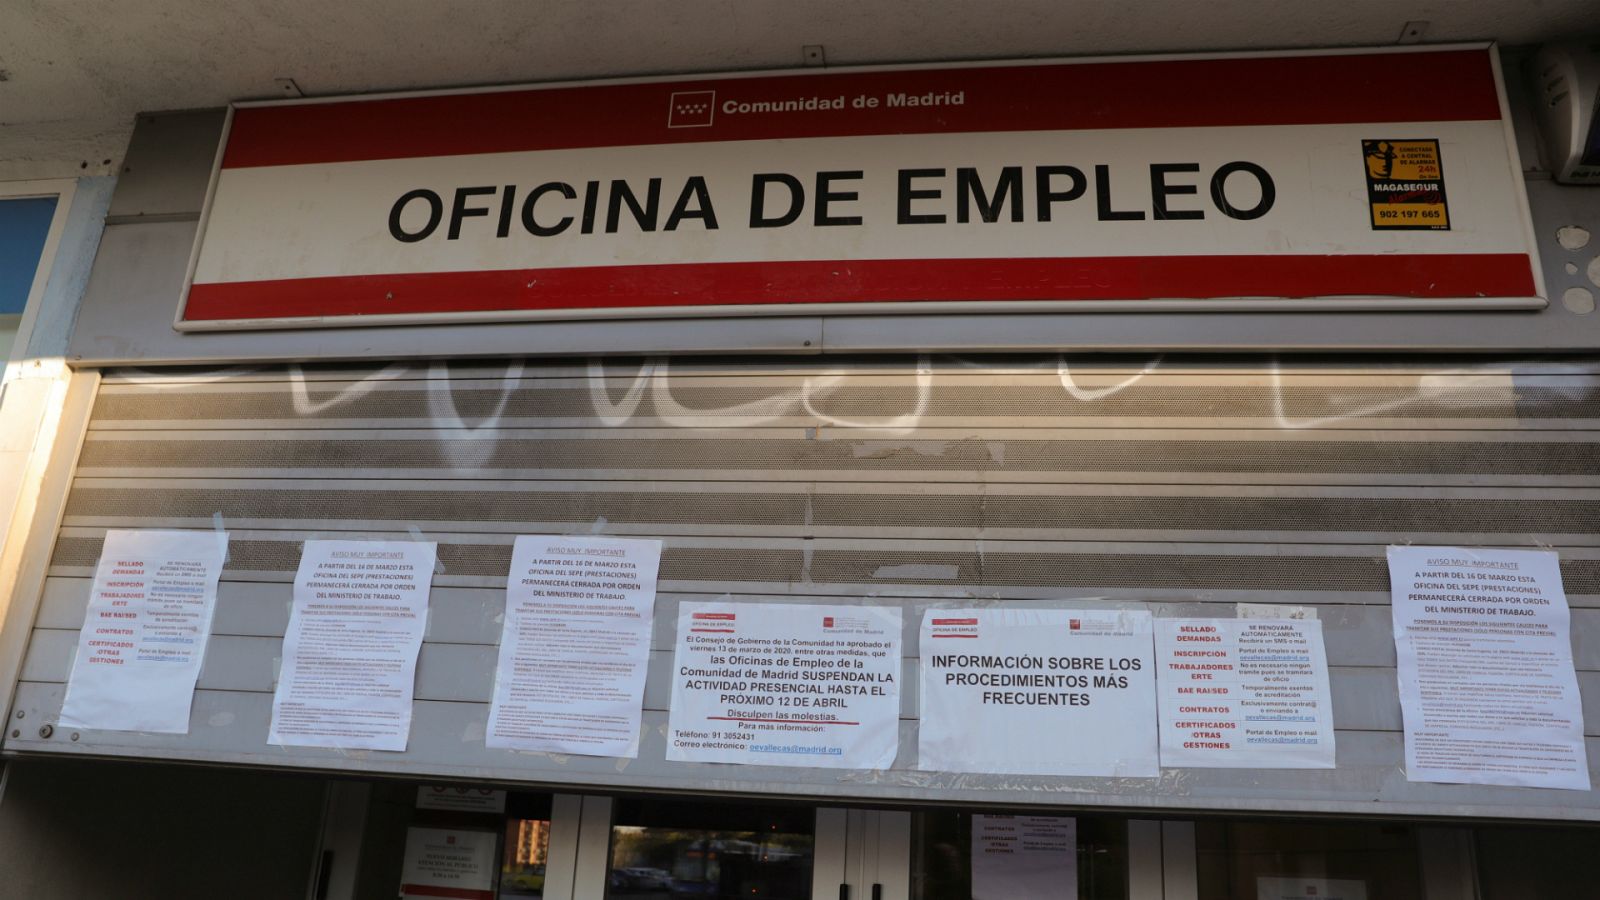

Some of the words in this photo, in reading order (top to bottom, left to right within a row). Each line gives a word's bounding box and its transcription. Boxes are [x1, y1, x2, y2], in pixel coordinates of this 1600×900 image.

[722, 96, 845, 117] Comunidad
[851, 94, 877, 111] de
[885, 90, 965, 108] Madrid
[386, 175, 719, 244] OFICINA
[748, 170, 864, 230] DE
[896, 160, 1276, 226] EMPLEO
[1472, 560, 1518, 570] IMPORTANTE
[1482, 585, 1541, 594] (PRESTACIONES)
[696, 636, 724, 645] Consejo
[711, 656, 725, 664] las
[729, 656, 774, 666] Oficinas
[777, 658, 789, 667] de
[793, 658, 833, 669] Empleo
[837, 659, 851, 668] de
[854, 660, 863, 668] la
[932, 653, 1043, 669] INFORMACIÓN
[1048, 657, 1104, 670] SOBRE
[1109, 658, 1141, 670] LOS
[681, 667, 741, 678] Comunidad
[745, 668, 757, 678] de
[762, 669, 798, 679] Madrid
[802, 671, 874, 682] SUSPENDAN
[878, 672, 893, 682] LA
[946, 673, 1088, 688] PROCEDIMIENTOS
[1093, 673, 1128, 688] MÁS
[686, 680, 746, 691] ACTIVIDAD
[751, 682, 824, 694] PRESENCIAL
[828, 685, 867, 695] HASTA
[871, 686, 886, 696] EL
[720, 692, 774, 706] PRÓXIMO
[778, 697, 789, 706] 12
[794, 697, 808, 706] DE
[814, 698, 848, 708] ABRIL
[983, 692, 1090, 706] FRECUENTES
[728, 709, 773, 720] Disculpen
[792, 712, 839, 720] molestias.
[674, 740, 700, 748] Correo
